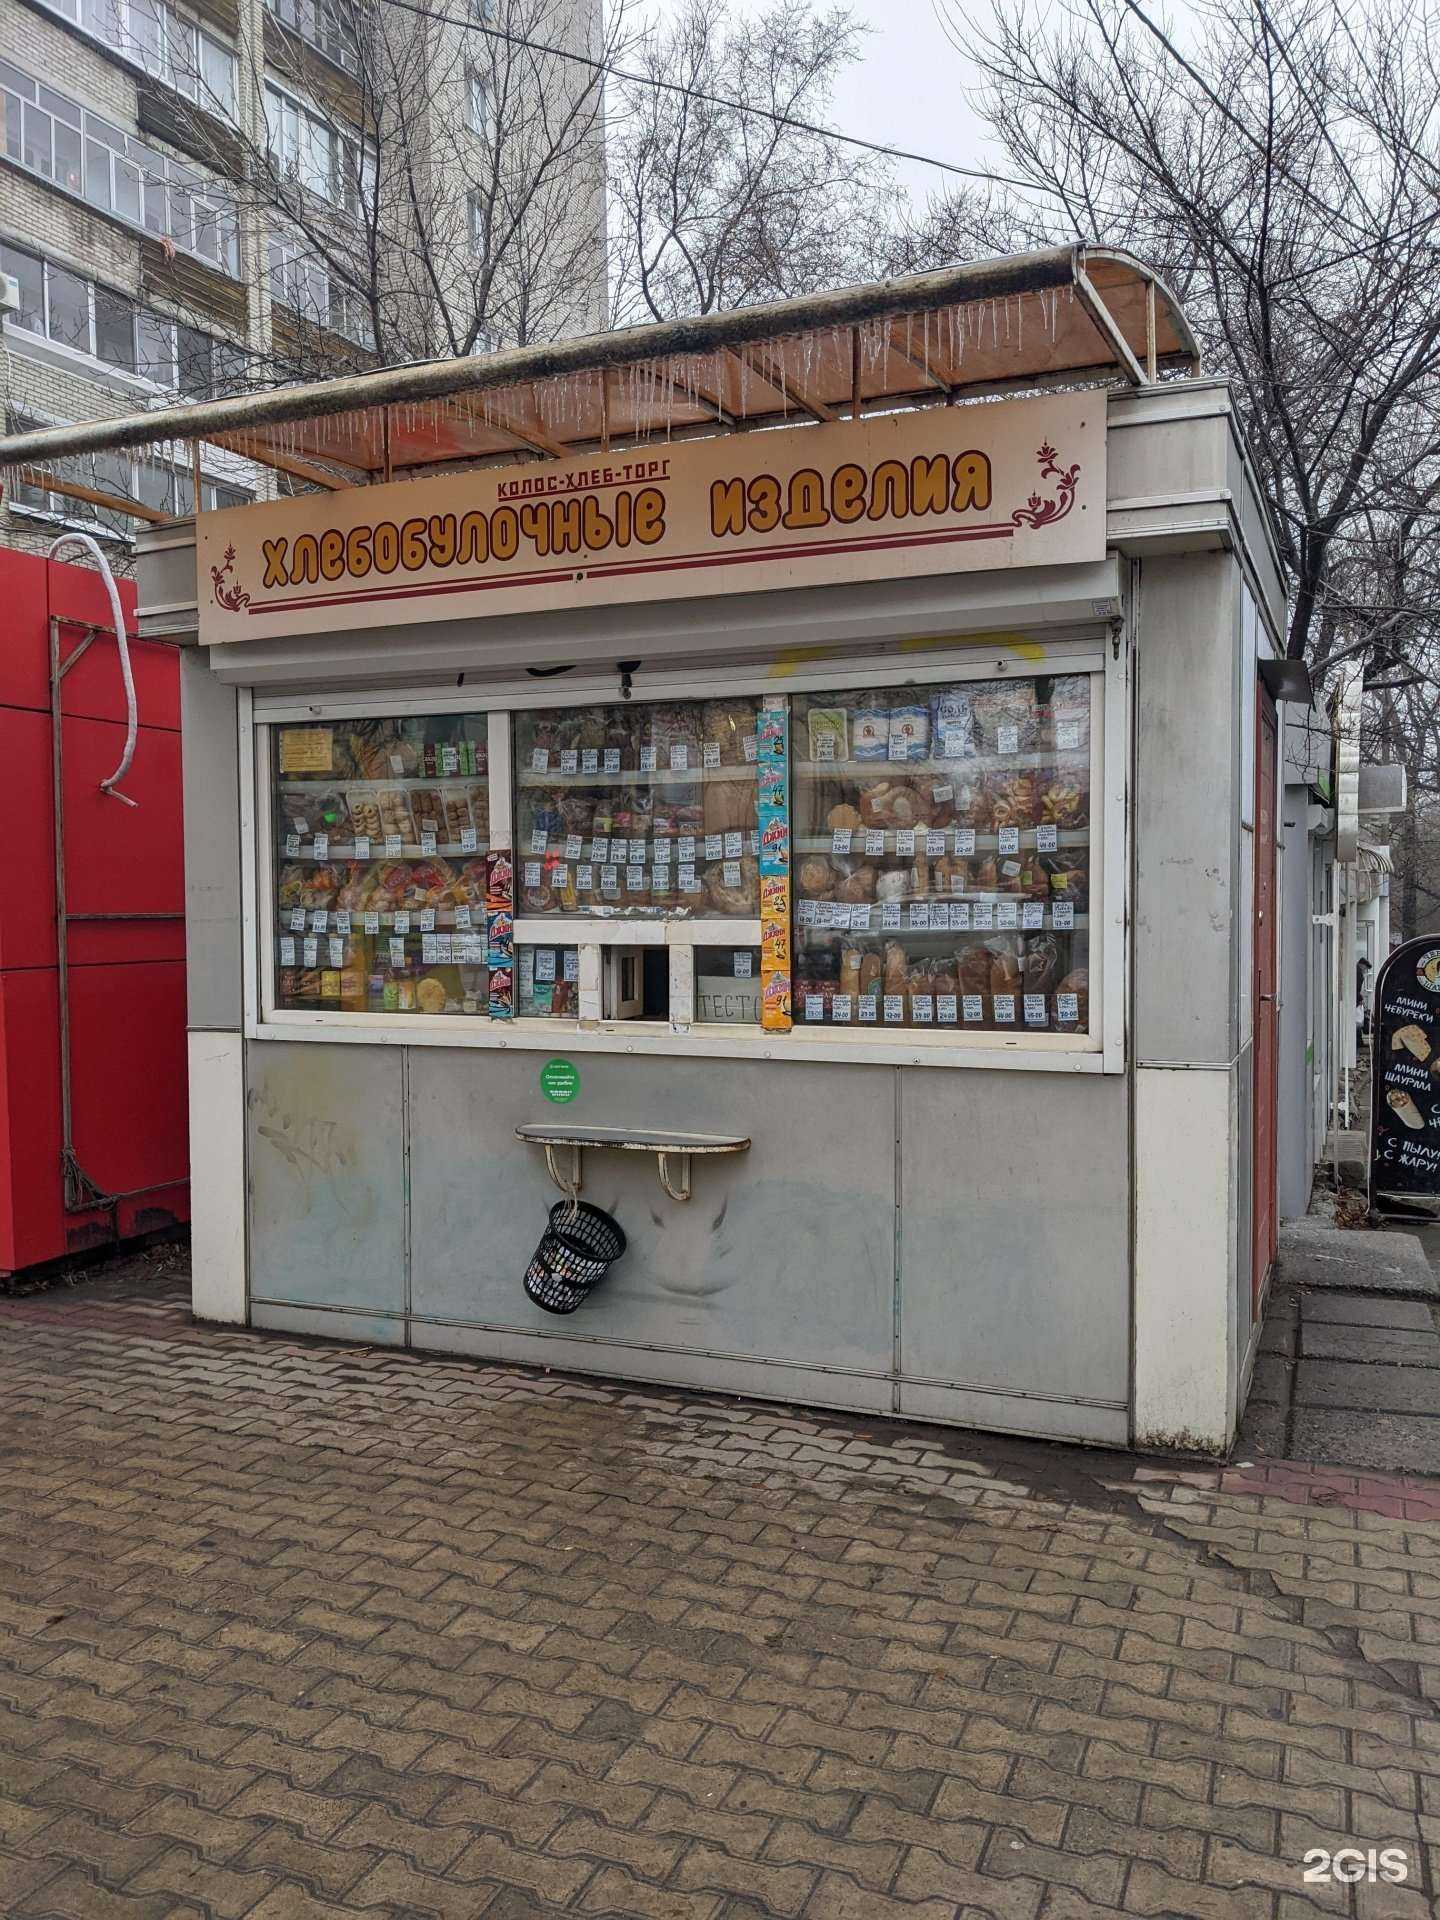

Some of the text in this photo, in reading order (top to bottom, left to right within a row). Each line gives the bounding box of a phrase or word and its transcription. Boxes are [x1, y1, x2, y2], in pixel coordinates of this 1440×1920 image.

[498, 460, 671, 498] КОЛОС-ХЛЕБ-ТОРГ
[262, 450, 992, 589] ХЛЕБОБУЛОЧНЫЕ ИЗДЕЛИЯ
[773, 785, 785, 797] 47
[774, 895, 787, 906] 25
[775, 939, 786, 949] 47
[776, 994, 787, 1009] 91
[1396, 996, 1428, 1011] МИНИ
[1384, 1003, 1434, 1024] ЧЕБУРЕКИ
[1394, 1063, 1429, 1079] МИНИ
[1384, 1072, 1432, 1092] ШАУРМА
[1387, 1137, 1398, 1148] С
[1384, 1149, 1394, 1160] С
